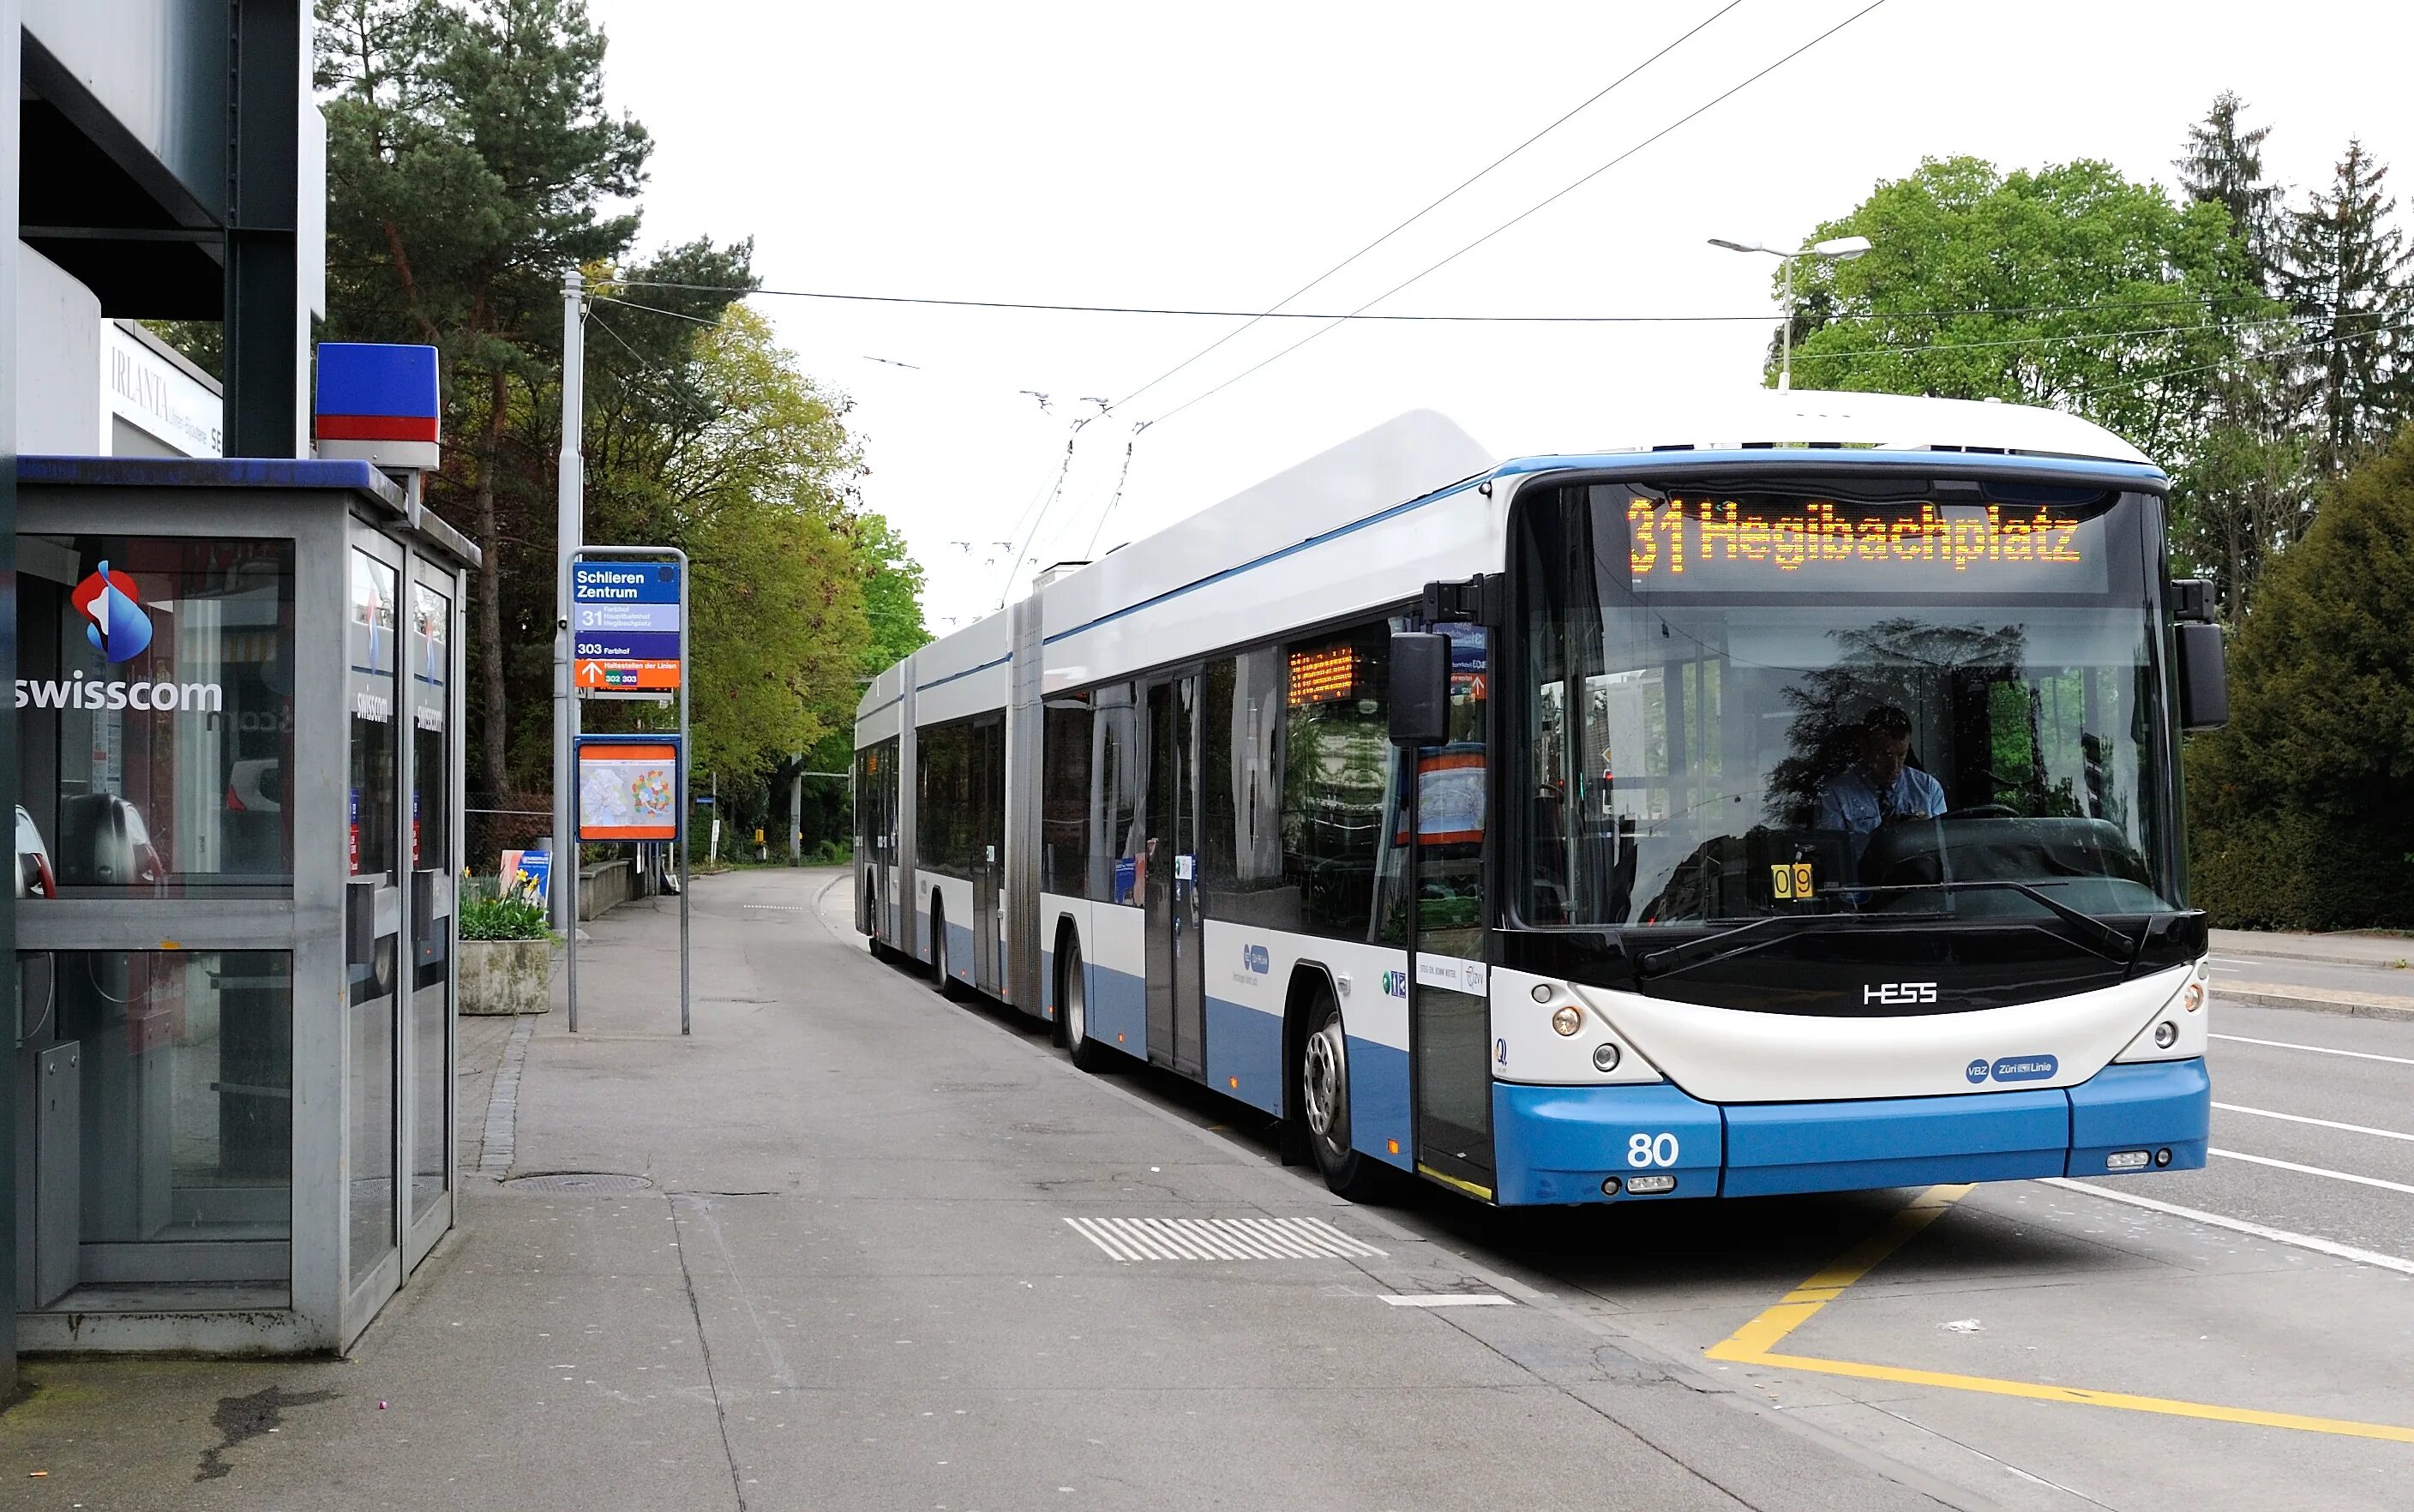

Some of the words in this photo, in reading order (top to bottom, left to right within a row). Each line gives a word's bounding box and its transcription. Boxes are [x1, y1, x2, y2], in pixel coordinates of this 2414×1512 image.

[1629, 499, 1684, 572] 31
[1700, 501, 2081, 571] Hegibachplatz
[577, 570, 645, 584] Schlieren
[577, 585, 638, 598] Zentrum
[582, 610, 603, 627] 31
[578, 644, 602, 655] 303
[15, 669, 222, 711] swisscom
[357, 683, 387, 723] swisscom
[1775, 868, 1810, 893] 09
[1864, 982, 1937, 1005] HESS
[1968, 1065, 1988, 1076] VBZ
[1999, 1064, 2017, 1075] Züri
[2031, 1062, 2052, 1072] Linie
[1627, 1132, 1679, 1167] 80
